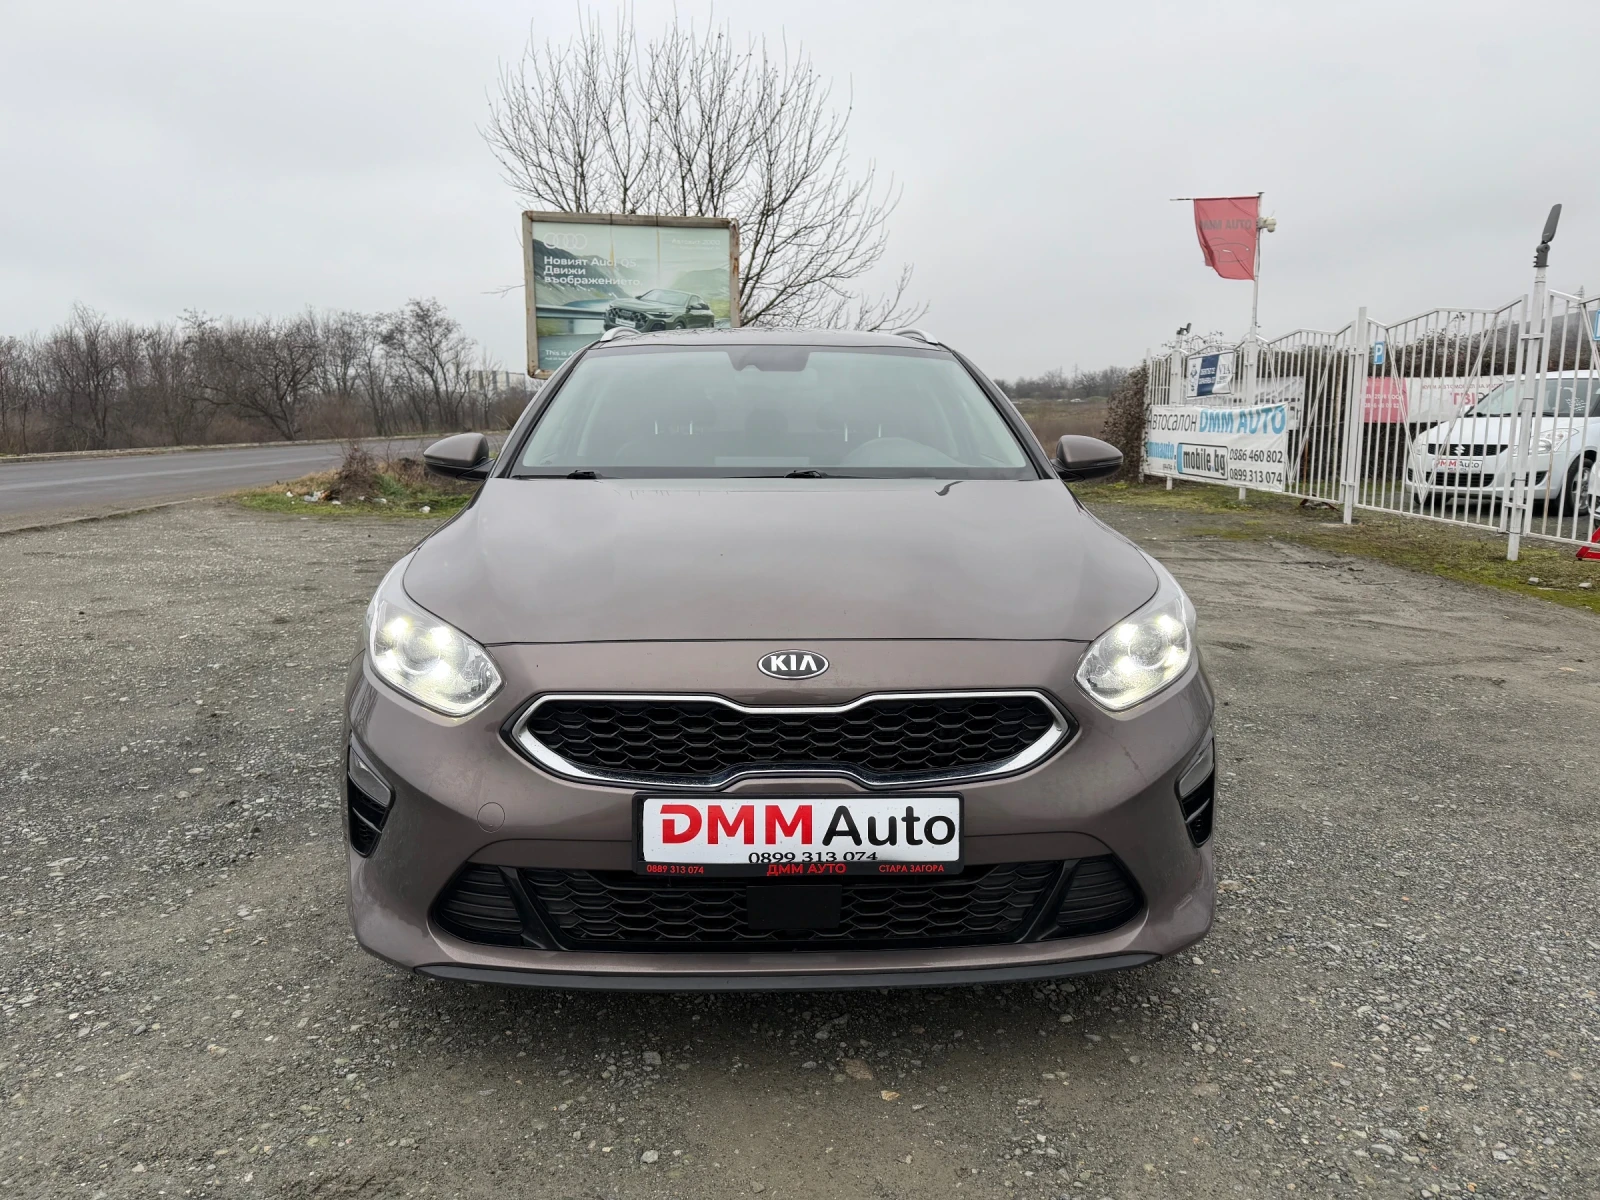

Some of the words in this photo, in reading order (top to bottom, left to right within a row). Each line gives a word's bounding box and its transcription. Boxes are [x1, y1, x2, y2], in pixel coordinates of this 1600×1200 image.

[1225, 219, 1252, 230] AUTO
[543, 256, 588, 266] Новият
[543, 265, 586, 275] Движи
[1199, 409, 1234, 433] DMM
[1237, 406, 1286, 434] AUTO
[1183, 448, 1226, 477] mobile.bg
[1229, 449, 1248, 461] 0886
[1249, 449, 1265, 462] 460
[1266, 450, 1283, 463] 802
[1229, 468, 1247, 481] 0899
[1249, 470, 1264, 483] 313
[1265, 471, 1283, 485] 074
[770, 655, 818, 671] KIA
[822, 805, 956, 846] Auto
[748, 851, 795, 863] 0899
[801, 851, 837, 863] 313
[843, 851, 879, 862] 074
[646, 864, 668, 873] 0889
[670, 865, 686, 874] 313
[688, 865, 704, 875] 074
[767, 863, 804, 876] ДММ
[807, 863, 846, 873] АУТО
[879, 864, 908, 873] СТАРА
[910, 864, 945, 873] ЗАГОРА
